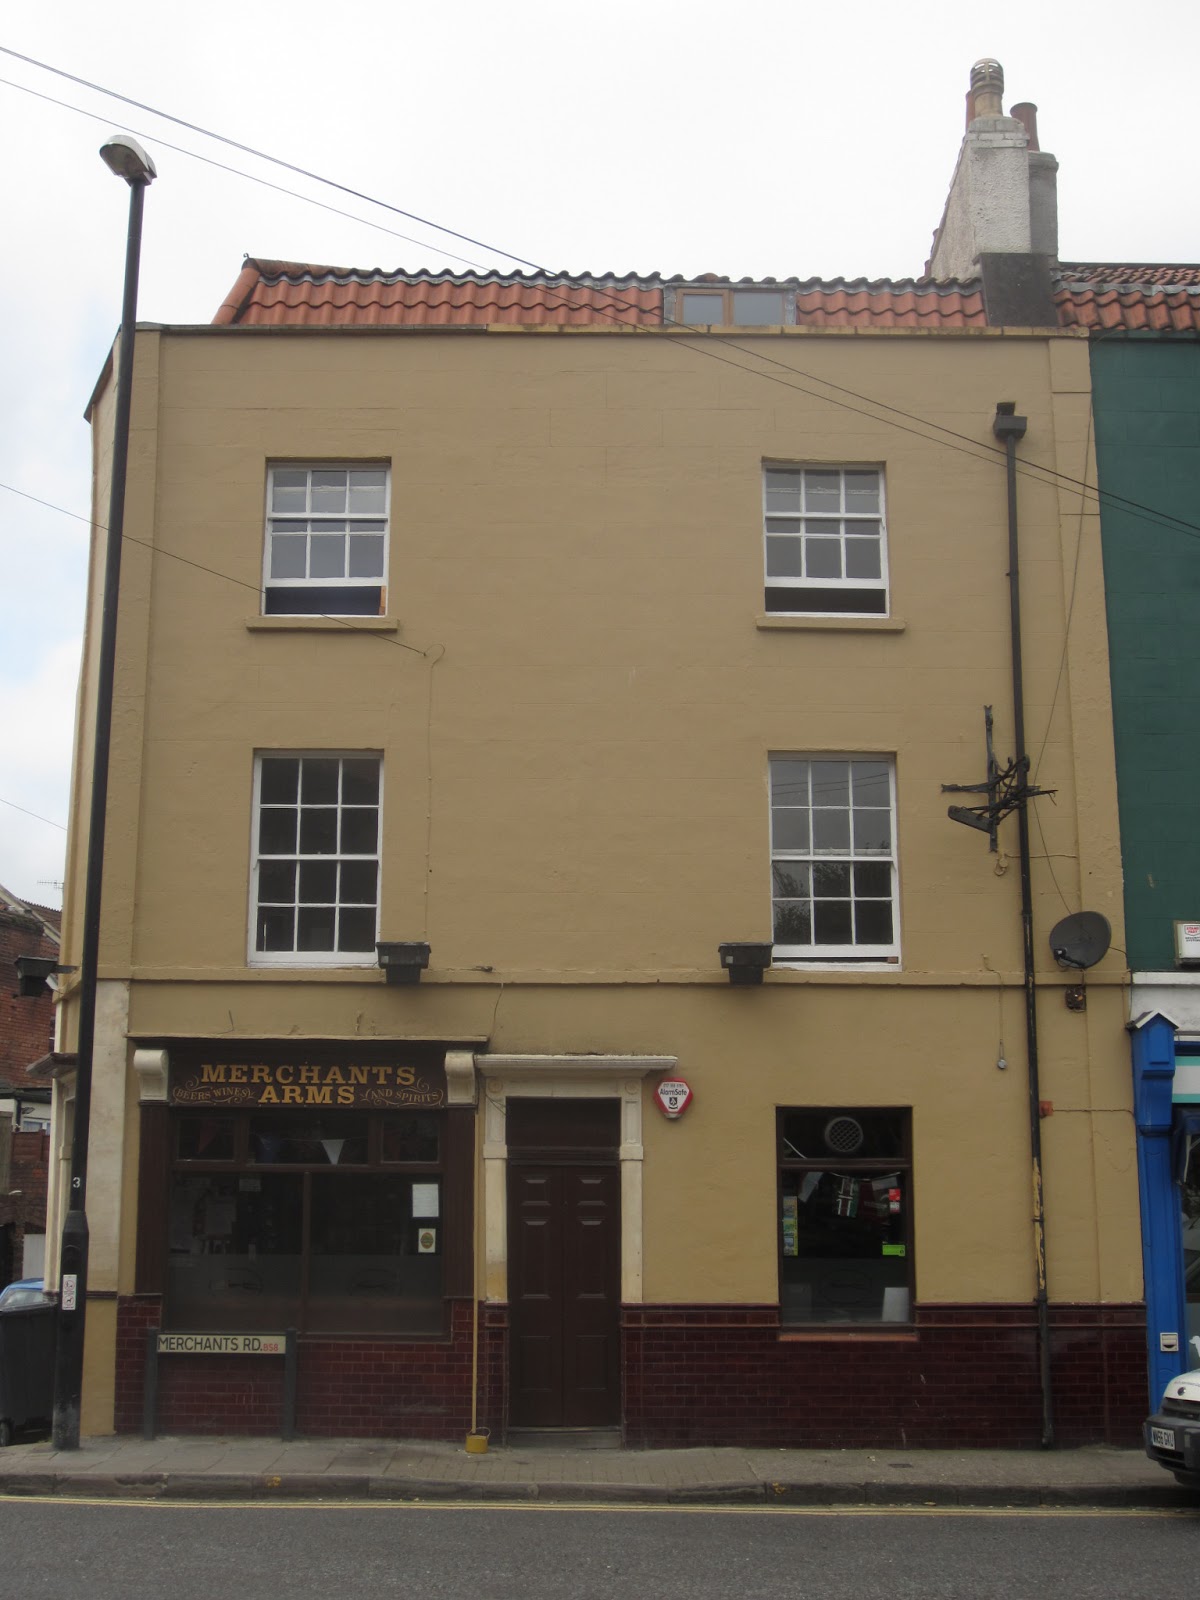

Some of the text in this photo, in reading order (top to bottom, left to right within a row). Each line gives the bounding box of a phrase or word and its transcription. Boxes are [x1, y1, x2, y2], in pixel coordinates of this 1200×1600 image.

[201, 1064, 416, 1085] MERCHANTS
[176, 1087, 248, 1101] BEERS WINES
[258, 1085, 355, 1104] ARMS
[371, 1088, 439, 1104] AND SPIRITS
[72, 1177, 81, 1188] 3
[158, 1337, 238, 1351] MERCHANTS
[263, 1343, 279, 1352] BS8
